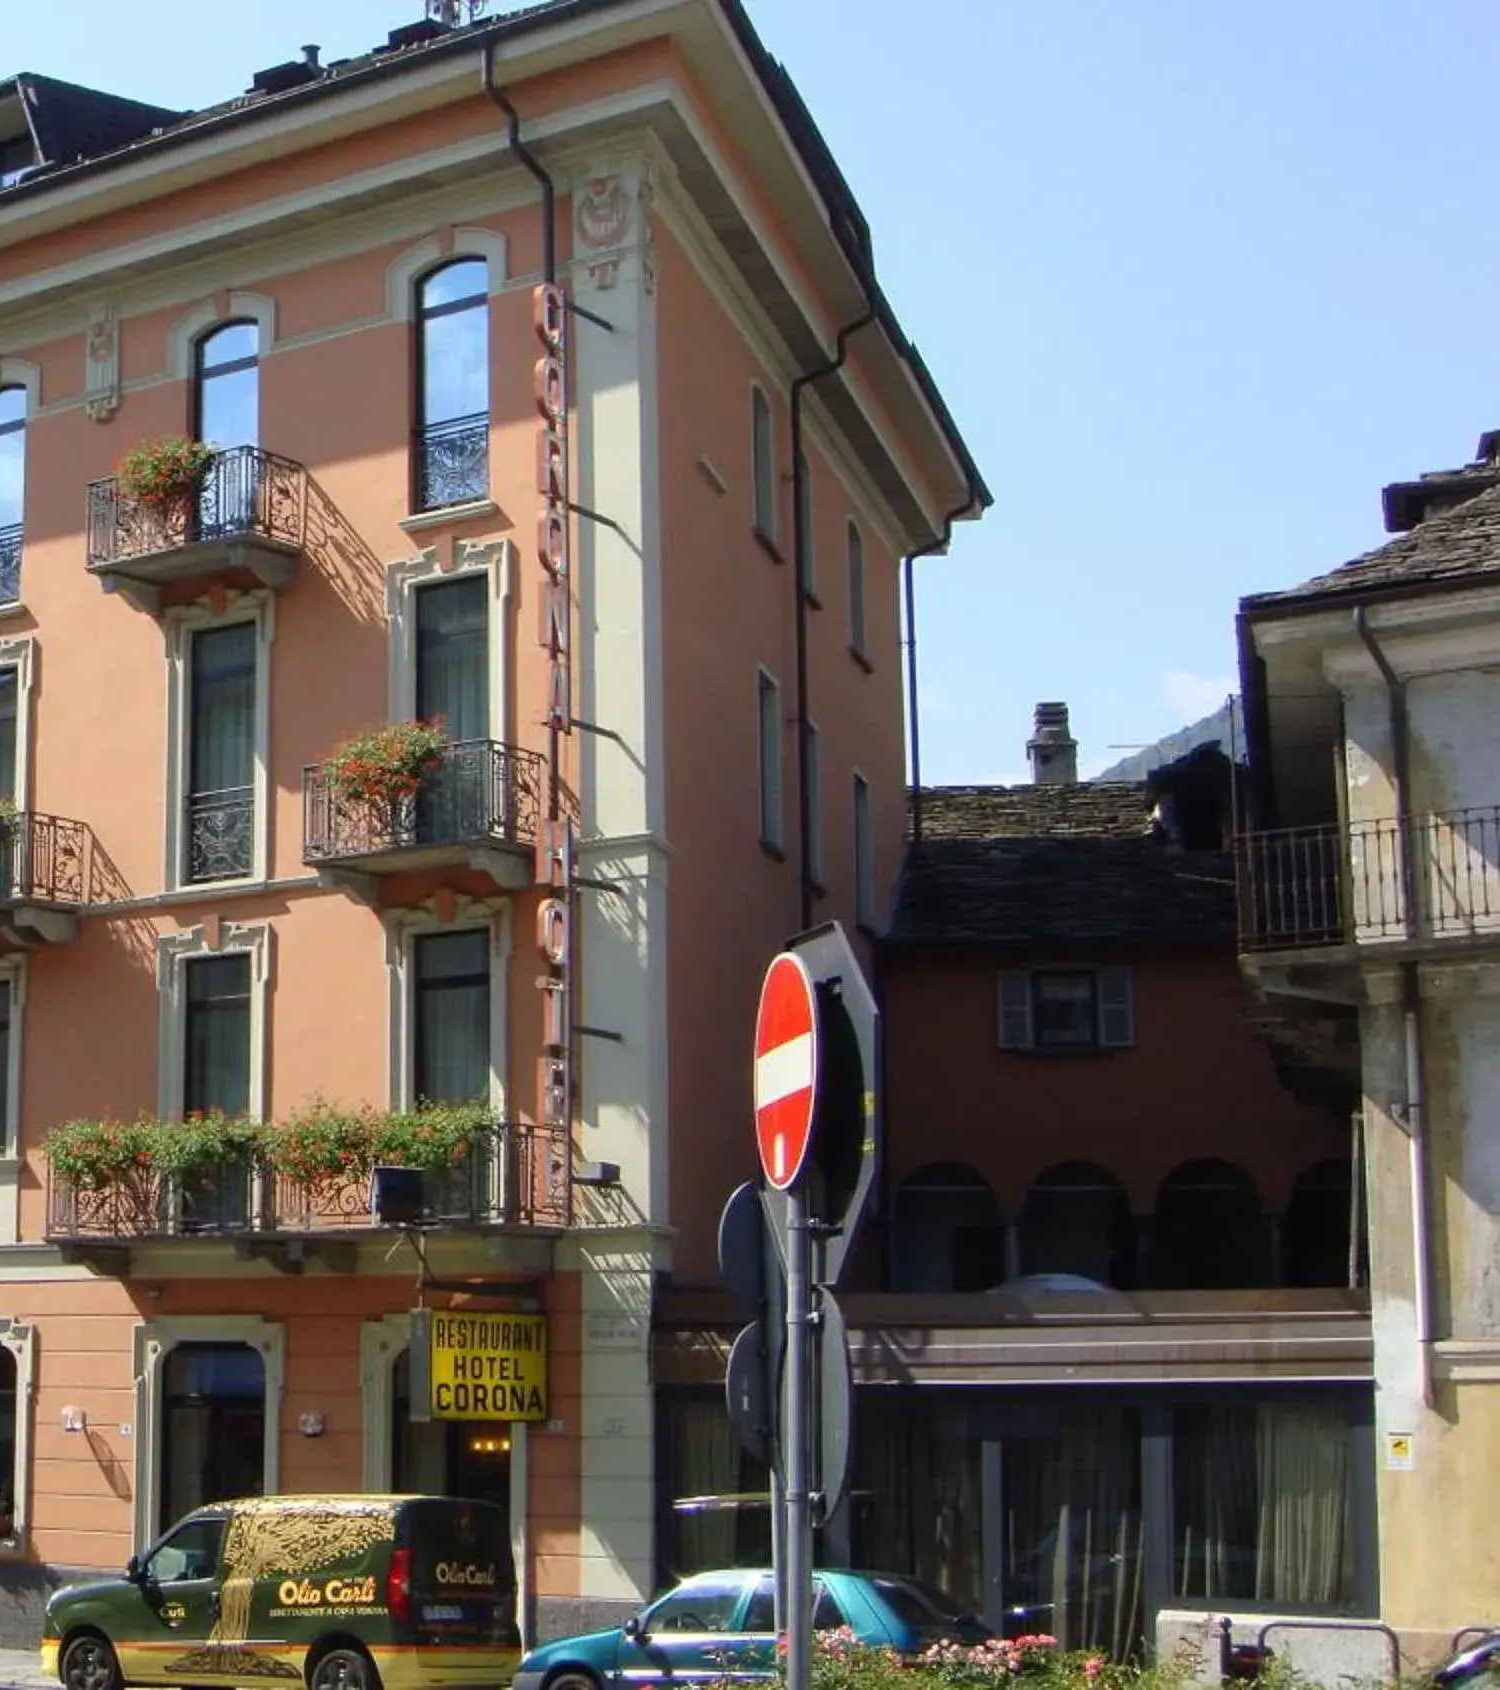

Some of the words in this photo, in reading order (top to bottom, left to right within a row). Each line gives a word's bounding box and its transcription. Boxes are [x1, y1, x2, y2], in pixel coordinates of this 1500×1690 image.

[534, 283, 566, 717] CORONA
[535, 817, 567, 1208] HOTEL
[435, 1318, 543, 1352] RESTAURANT
[454, 1355, 525, 1381] HOTEL
[436, 1383, 543, 1413] CORONA
[279, 1578, 320, 1605] Olio
[325, 1575, 376, 1603] Carli
